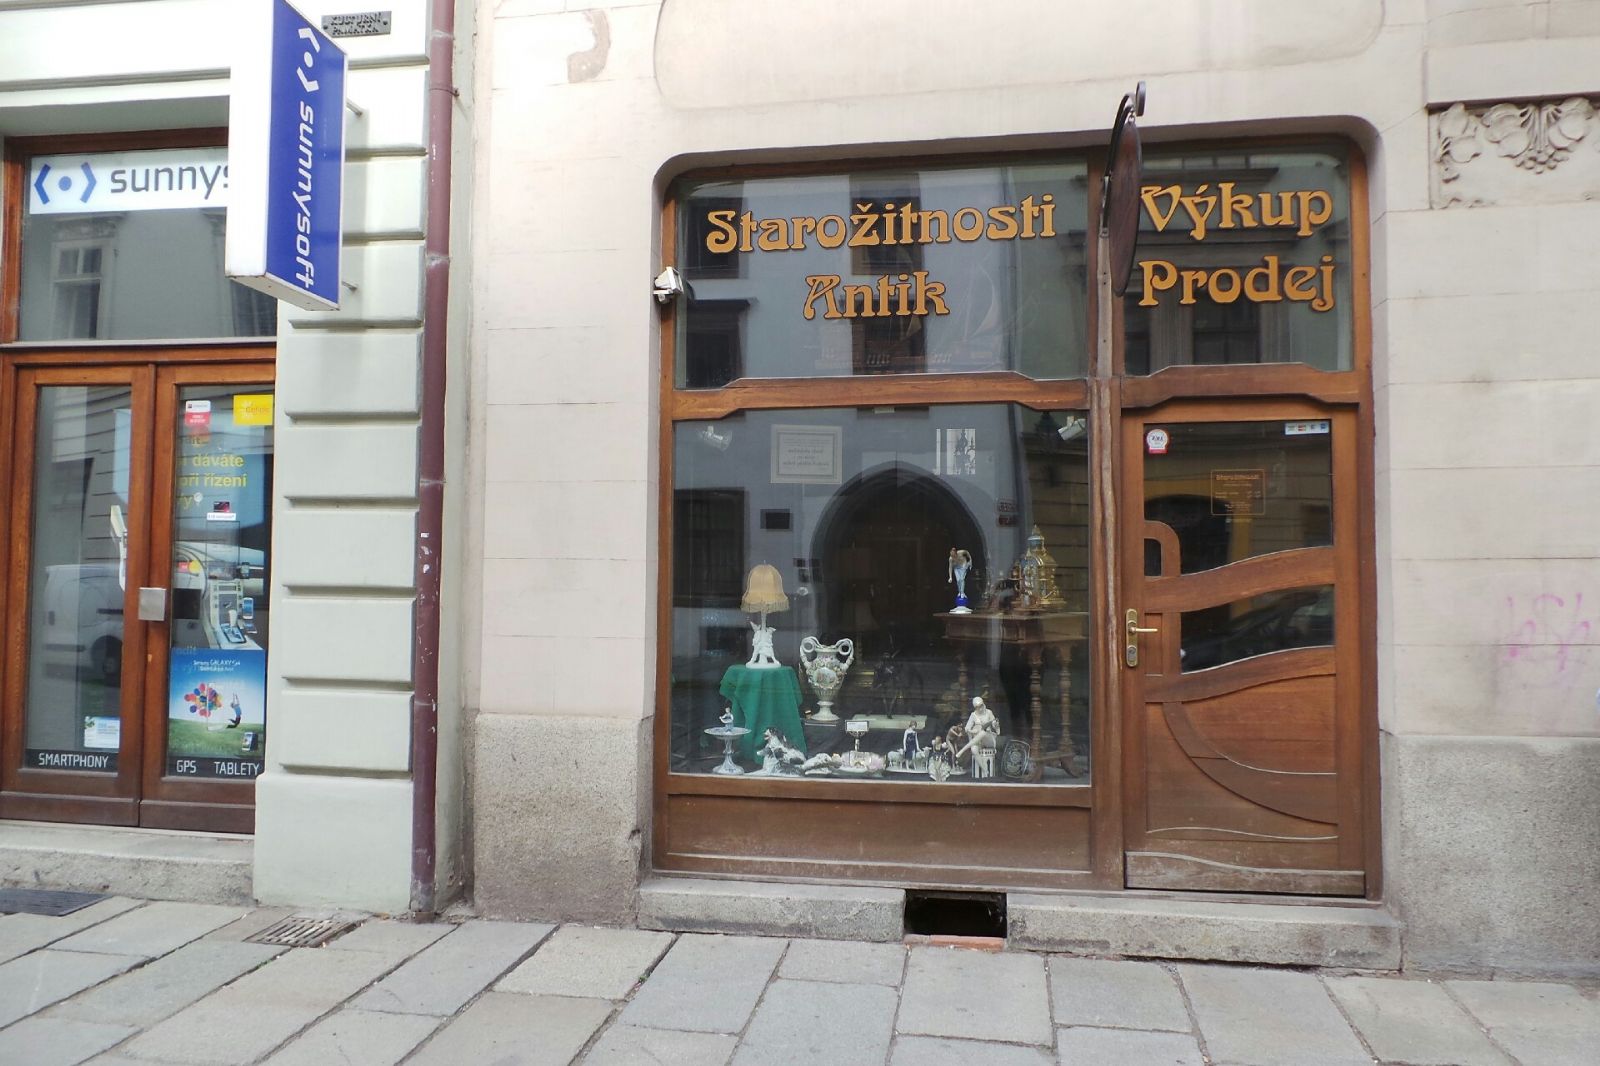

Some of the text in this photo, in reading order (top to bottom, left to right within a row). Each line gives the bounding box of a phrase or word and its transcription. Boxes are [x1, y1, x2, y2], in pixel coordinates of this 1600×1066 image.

[292, 100, 315, 289] sunnysoft
[1139, 181, 1334, 241] Výkup
[705, 193, 1057, 254] Starožitnosti
[802, 270, 951, 320] Antik
[1138, 254, 1336, 313] Prodej
[192, 453, 245, 468] dáváte
[204, 472, 248, 488] řízení
[38, 752, 109, 769] SMARTPHONY
[176, 759, 261, 777] GPS TABLETY
